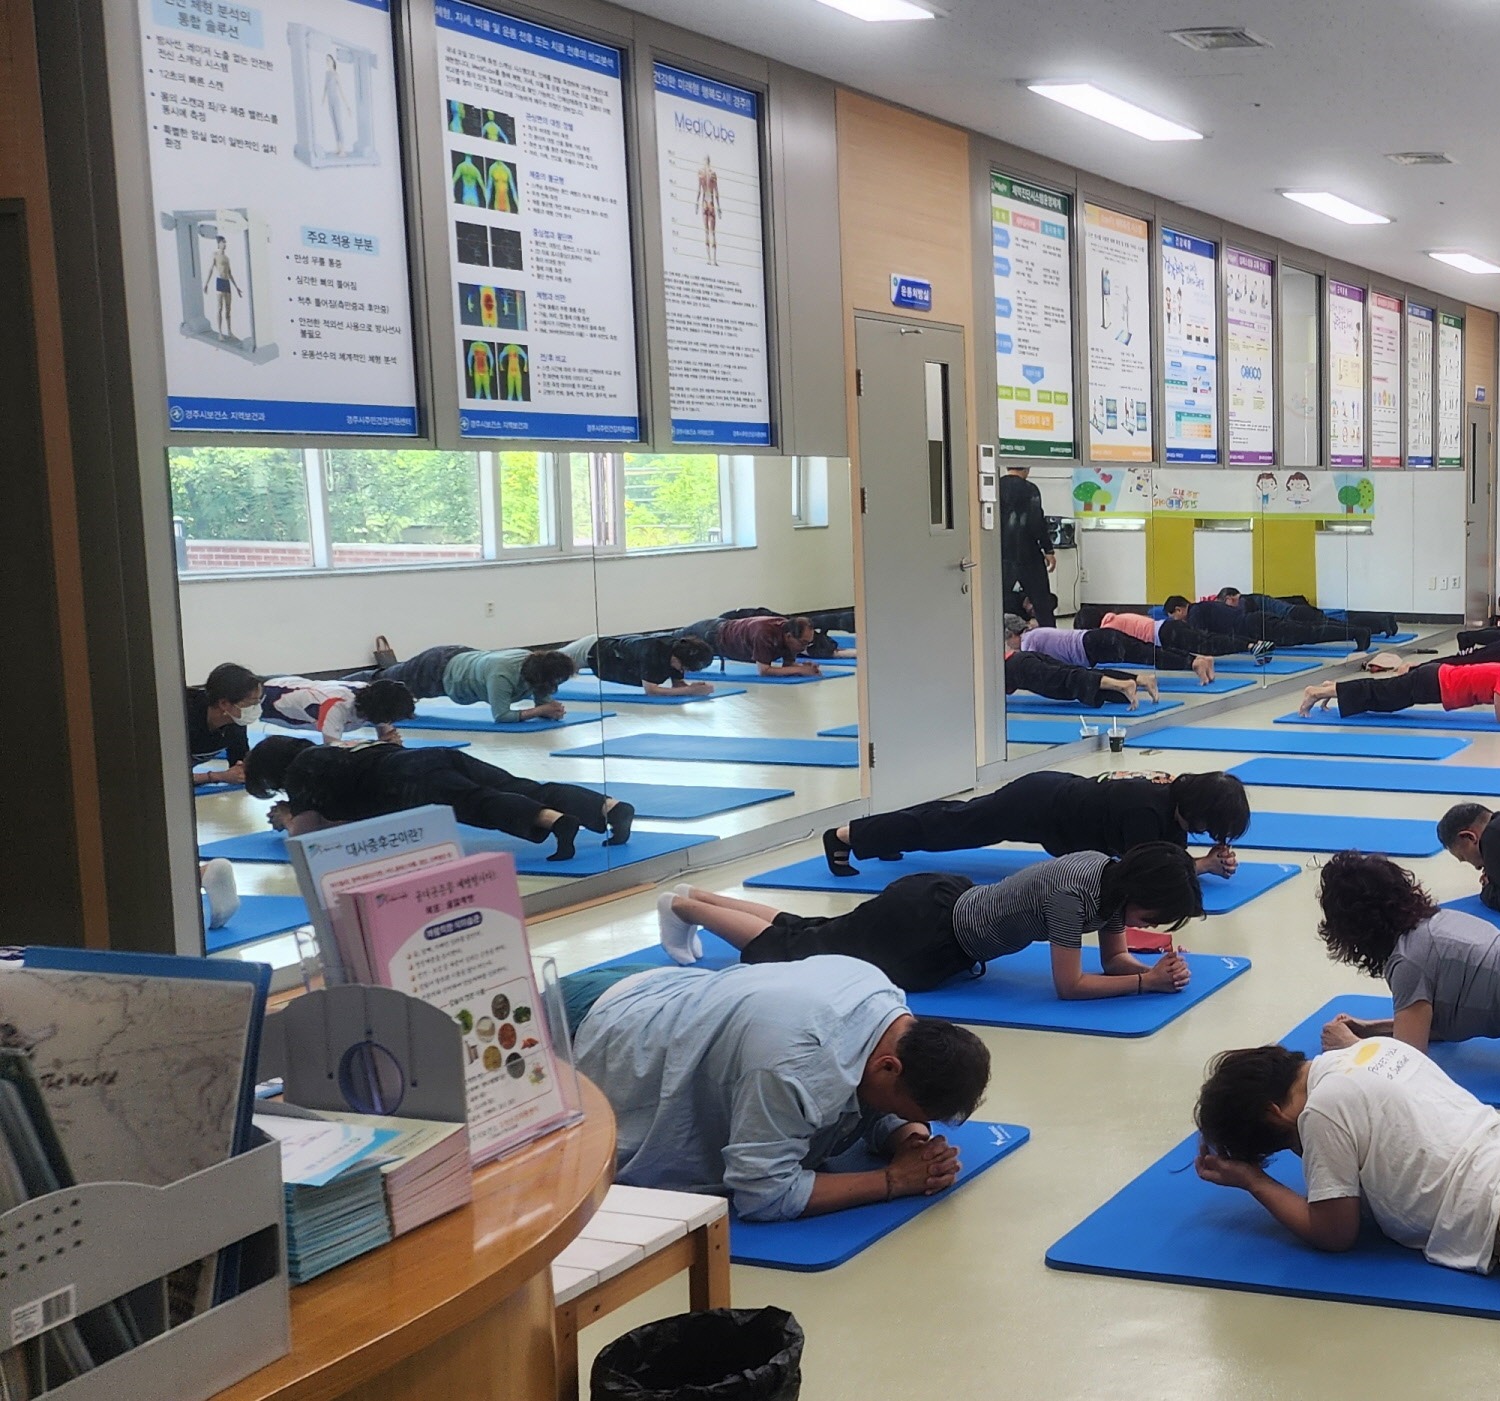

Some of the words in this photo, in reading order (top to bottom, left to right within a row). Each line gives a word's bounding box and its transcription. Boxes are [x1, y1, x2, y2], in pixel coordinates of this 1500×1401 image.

[217, 3, 251, 26] 분석의
[178, 11, 200, 30] 통합
[205, 19, 239, 39] 솔루션
[178, 53, 202, 67] 스캐닝
[205, 60, 229, 73] 시스템
[214, 49, 229, 61] 노출
[159, 69, 186, 83] 12초의
[189, 75, 205, 88] 빠른
[208, 80, 224, 91] 스캔
[654, 70, 677, 89] 건강한
[162, 104, 187, 118] 동시에
[190, 109, 206, 122] 측정
[181, 96, 205, 109] 스캔과
[248, 109, 278, 125] 밸런스를
[674, 111, 735, 144] MediCube
[163, 124, 188, 139] 특별한
[210, 134, 226, 145] 없이
[228, 137, 259, 152] 일반적인
[262, 143, 277, 155] 설치
[165, 137, 181, 150] 환경
[307, 230, 328, 244] 주요
[332, 234, 350, 249] 적용
[354, 237, 373, 252] 부분
[294, 254, 308, 264] 만성
[311, 256, 325, 267] 무릎
[328, 258, 342, 268] 통증
[296, 275, 317, 286] 심각한
[337, 280, 357, 291] 틀어짐
[299, 317, 320, 328] 안전한
[323, 319, 344, 330] 적외선
[346, 322, 373, 333] 사용으로
[300, 329, 321, 339] 불필요
[301, 350, 336, 361] 운동선수의
[384, 356, 397, 365] 분석
[185, 410, 228, 420] 경주시보건소
[230, 411, 266, 422] 지역보건과
[345, 828, 423, 857] 대사증후군이란?
